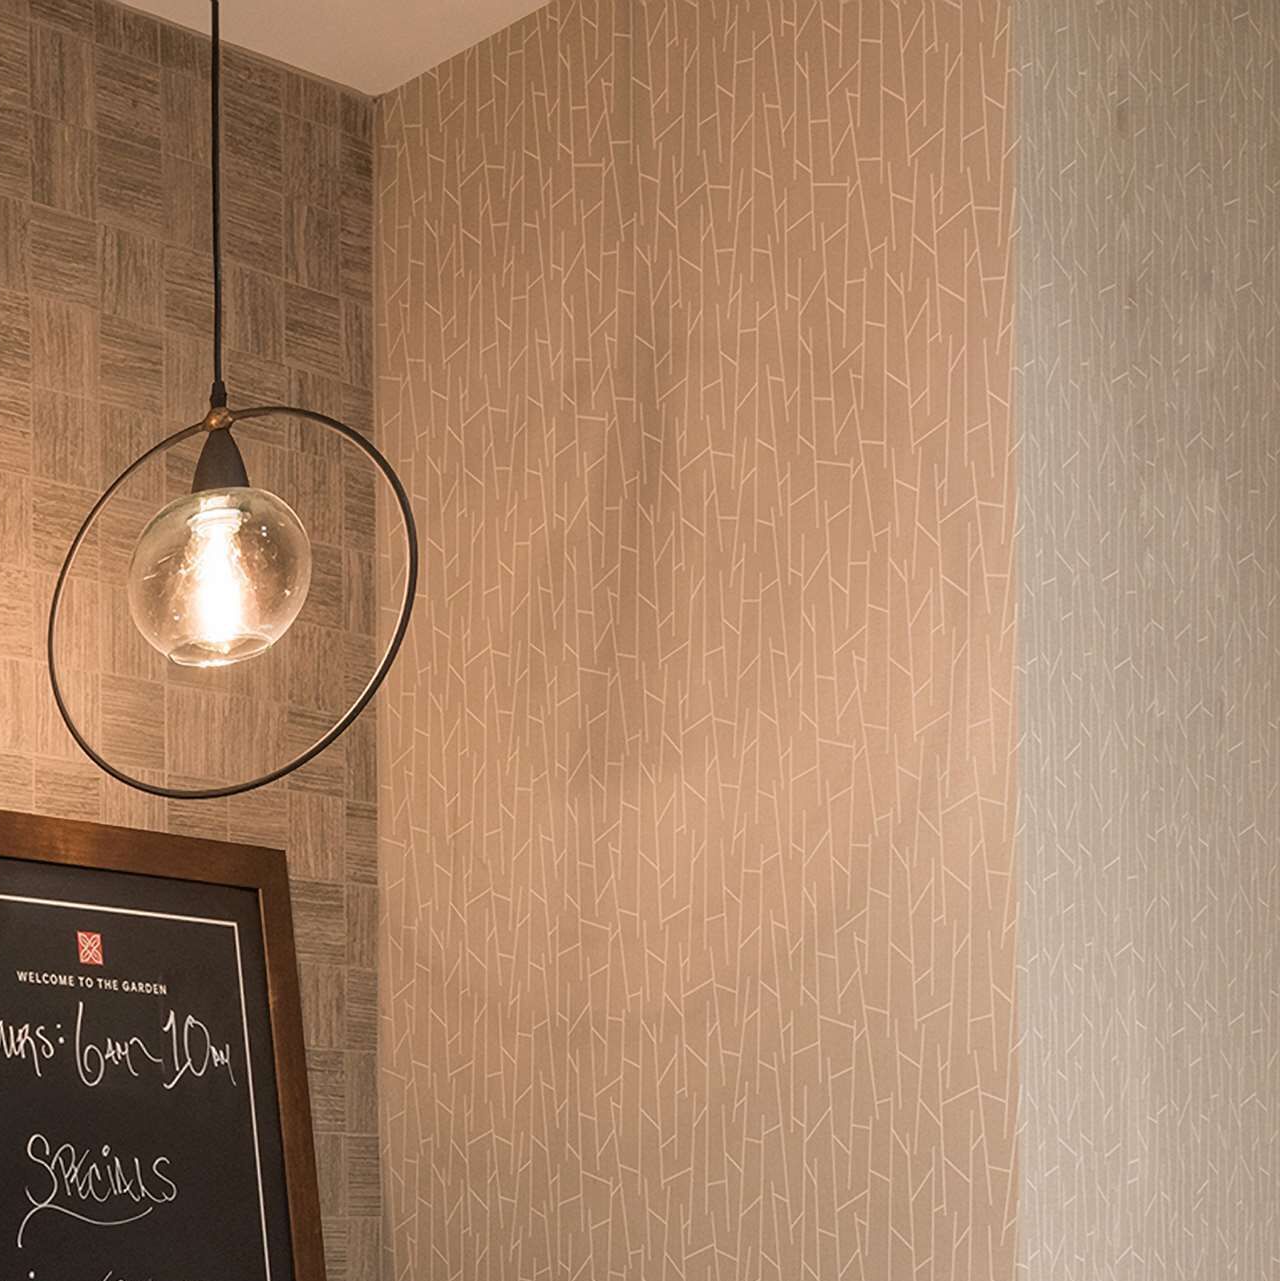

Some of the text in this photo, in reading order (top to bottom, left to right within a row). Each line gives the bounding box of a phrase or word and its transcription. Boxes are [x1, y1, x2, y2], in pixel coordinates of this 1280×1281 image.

[16, 970, 168, 995] WELCOME TO THE GARDEN
